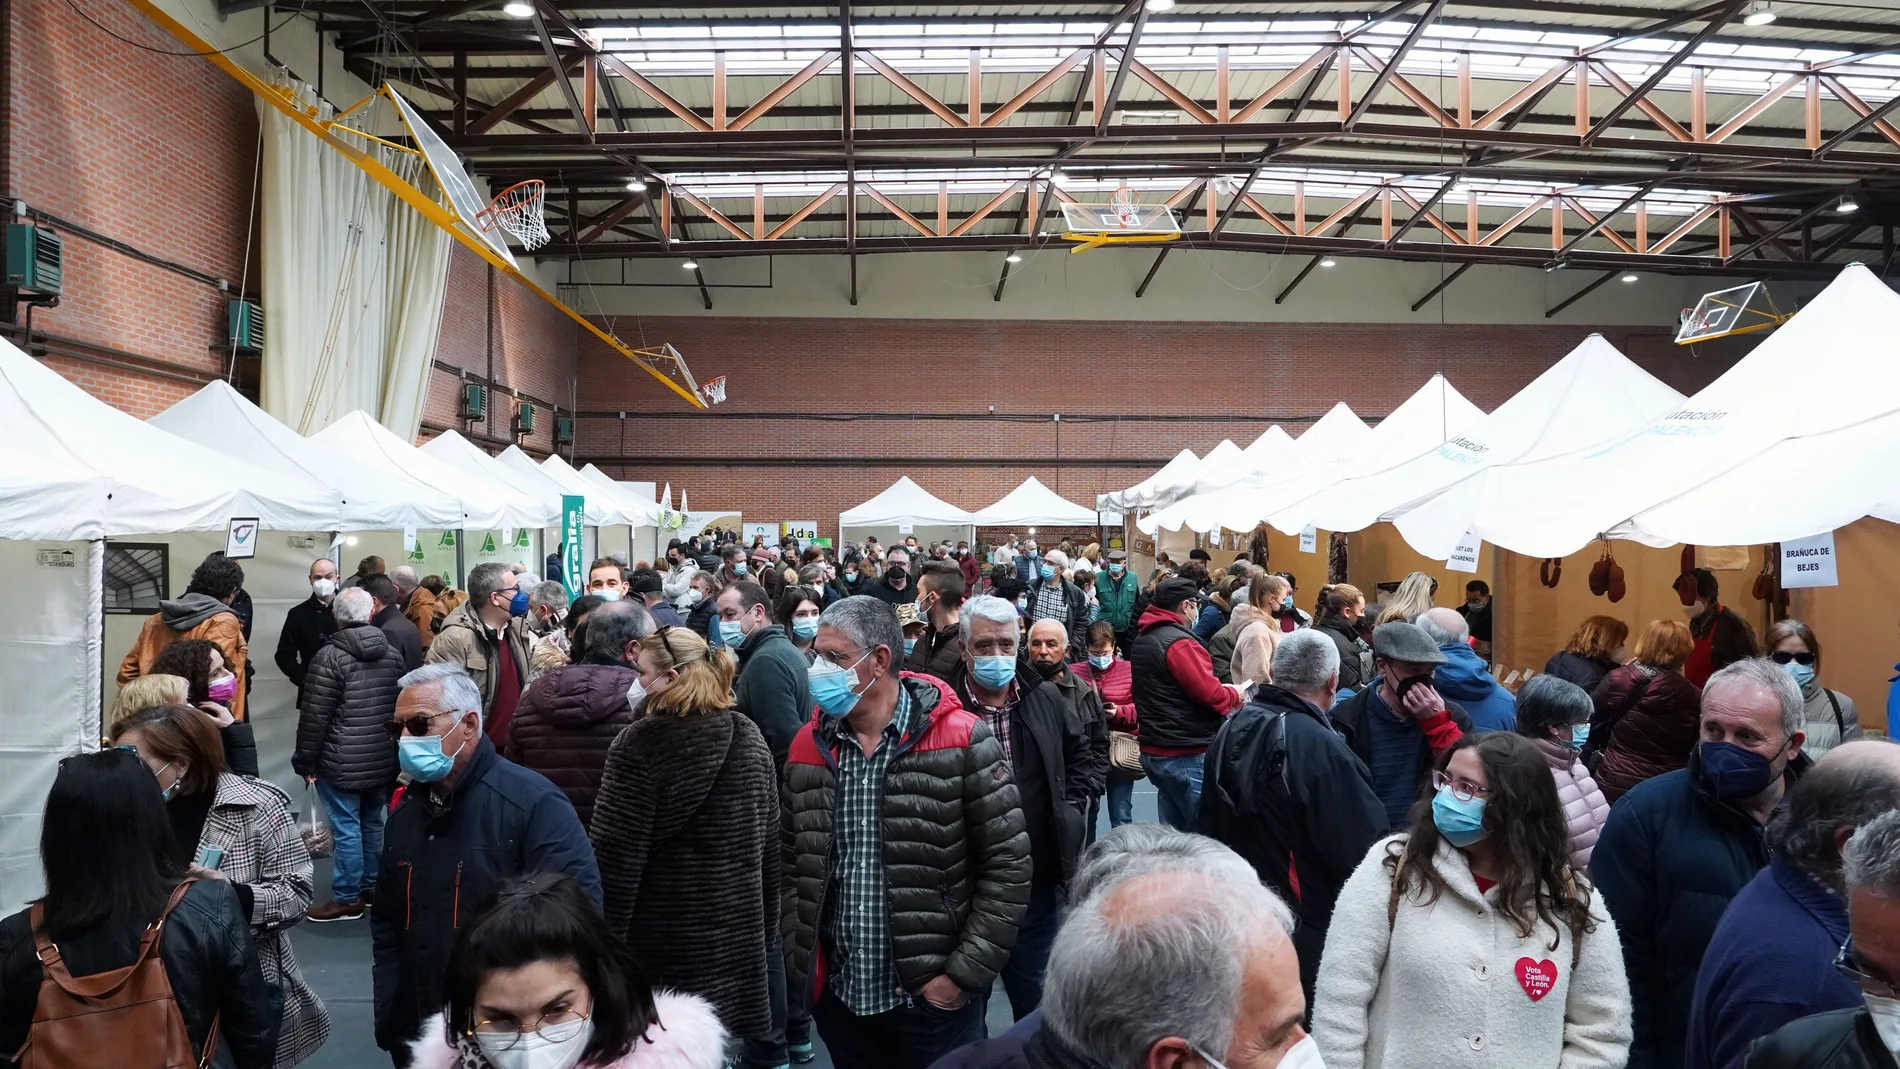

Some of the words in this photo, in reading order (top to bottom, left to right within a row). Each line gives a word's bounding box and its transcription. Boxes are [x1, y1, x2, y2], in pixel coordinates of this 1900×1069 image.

[567, 510, 581, 593] gralia
[1786, 547, 1819, 558] BRAÑUCA
[1820, 547, 1830, 555] DE
[1797, 562, 1820, 572] BEJES
[1525, 966, 1541, 974] Vota
[1525, 973, 1550, 982] Castilla
[1531, 979, 1550, 988] León.
